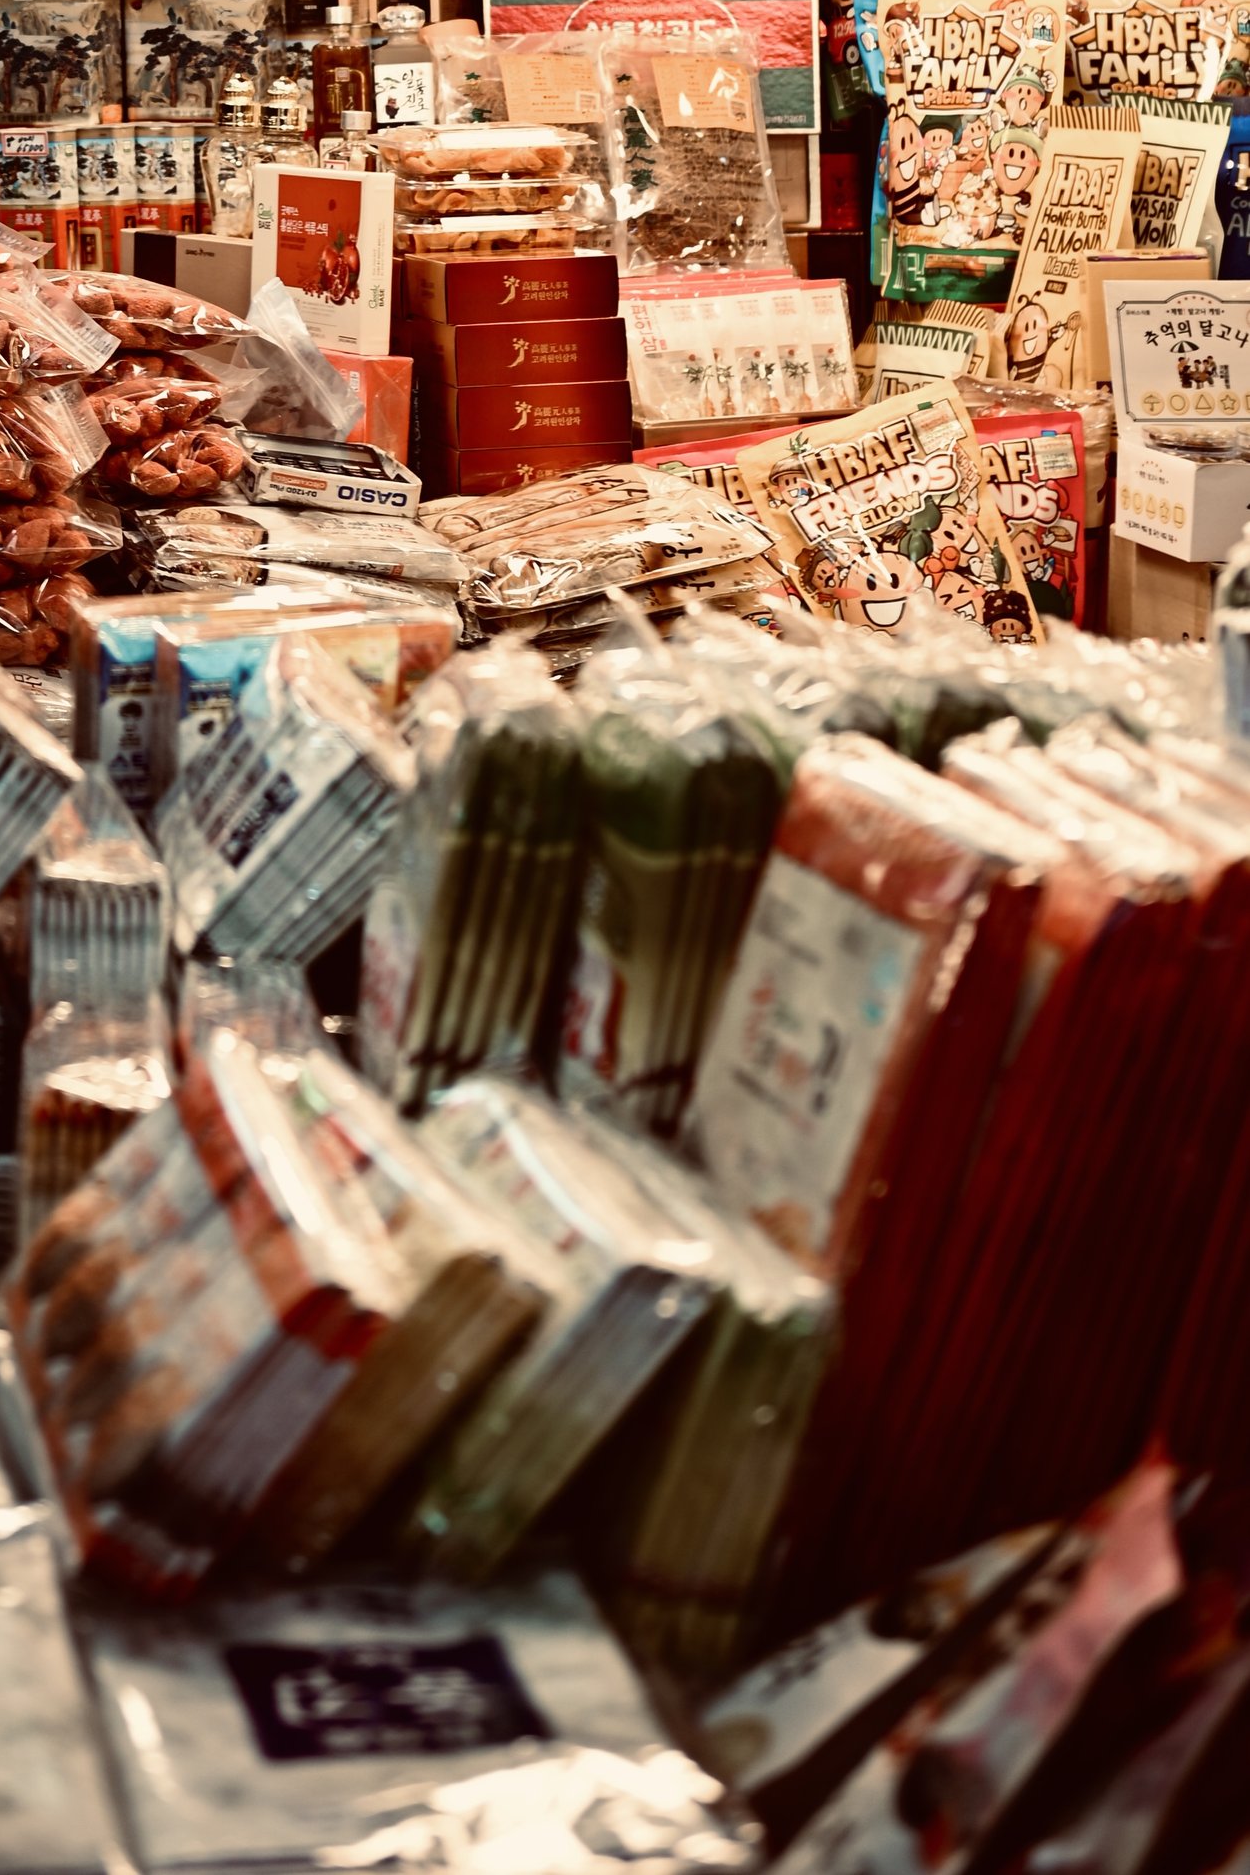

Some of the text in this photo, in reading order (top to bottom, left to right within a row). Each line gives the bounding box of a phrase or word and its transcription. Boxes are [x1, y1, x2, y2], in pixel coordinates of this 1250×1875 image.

[922, 13, 1004, 58] HBAF
[1093, 11, 1201, 55] HBAF
[922, 86, 974, 106] Picnic
[1049, 161, 1119, 210] HBAF
[1076, 211, 1108, 231] BUTTER
[1133, 219, 1177, 249] MOND
[1043, 256, 1080, 279] Mania
[521, 291, 569, 301] 고려원인삼차
[630, 304, 658, 353] 편인삼
[1144, 319, 1250, 349] 추억의 달고나
[531, 353, 578, 364] 고려원인삼차
[533, 416, 582, 427] 고려원인삼차
[803, 419, 916, 489] HBAF
[269, 483, 317, 498] DJ-120D Plus
[338, 485, 408, 507] CASIO
[791, 455, 959, 543] FRIENDS
